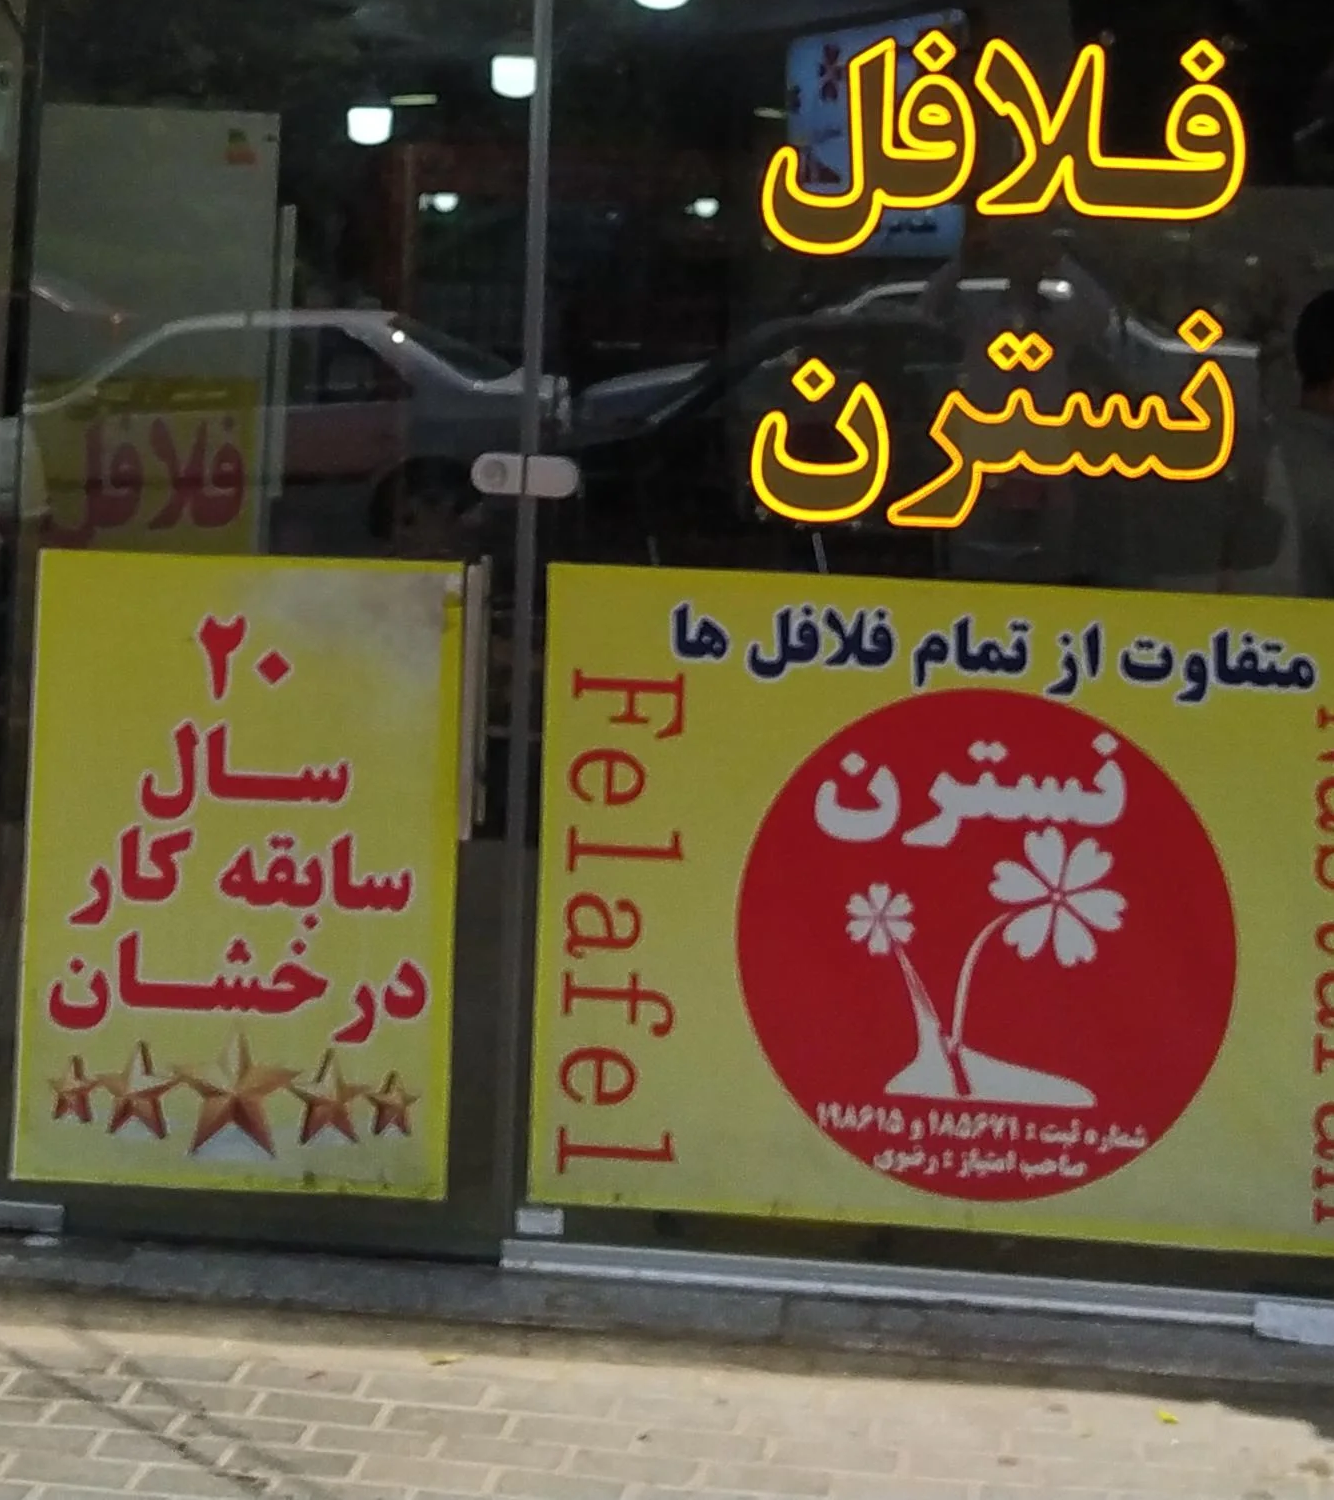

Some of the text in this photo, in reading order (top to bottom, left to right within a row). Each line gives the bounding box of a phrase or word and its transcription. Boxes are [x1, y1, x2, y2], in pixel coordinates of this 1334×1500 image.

[761, 29, 1247, 255] فلافل
[750, 308, 1235, 528] نسترن
[197, 614, 292, 700] ۲۰
[671, 601, 1318, 703] متفاوت از تمام فلافل ها
[139, 720, 351, 821] سال
[812, 731, 1129, 848] نسترن
[69, 826, 414, 930] سابقه کار
[555, 667, 688, 1174] Felafel
[47, 931, 429, 1045] درخشان
